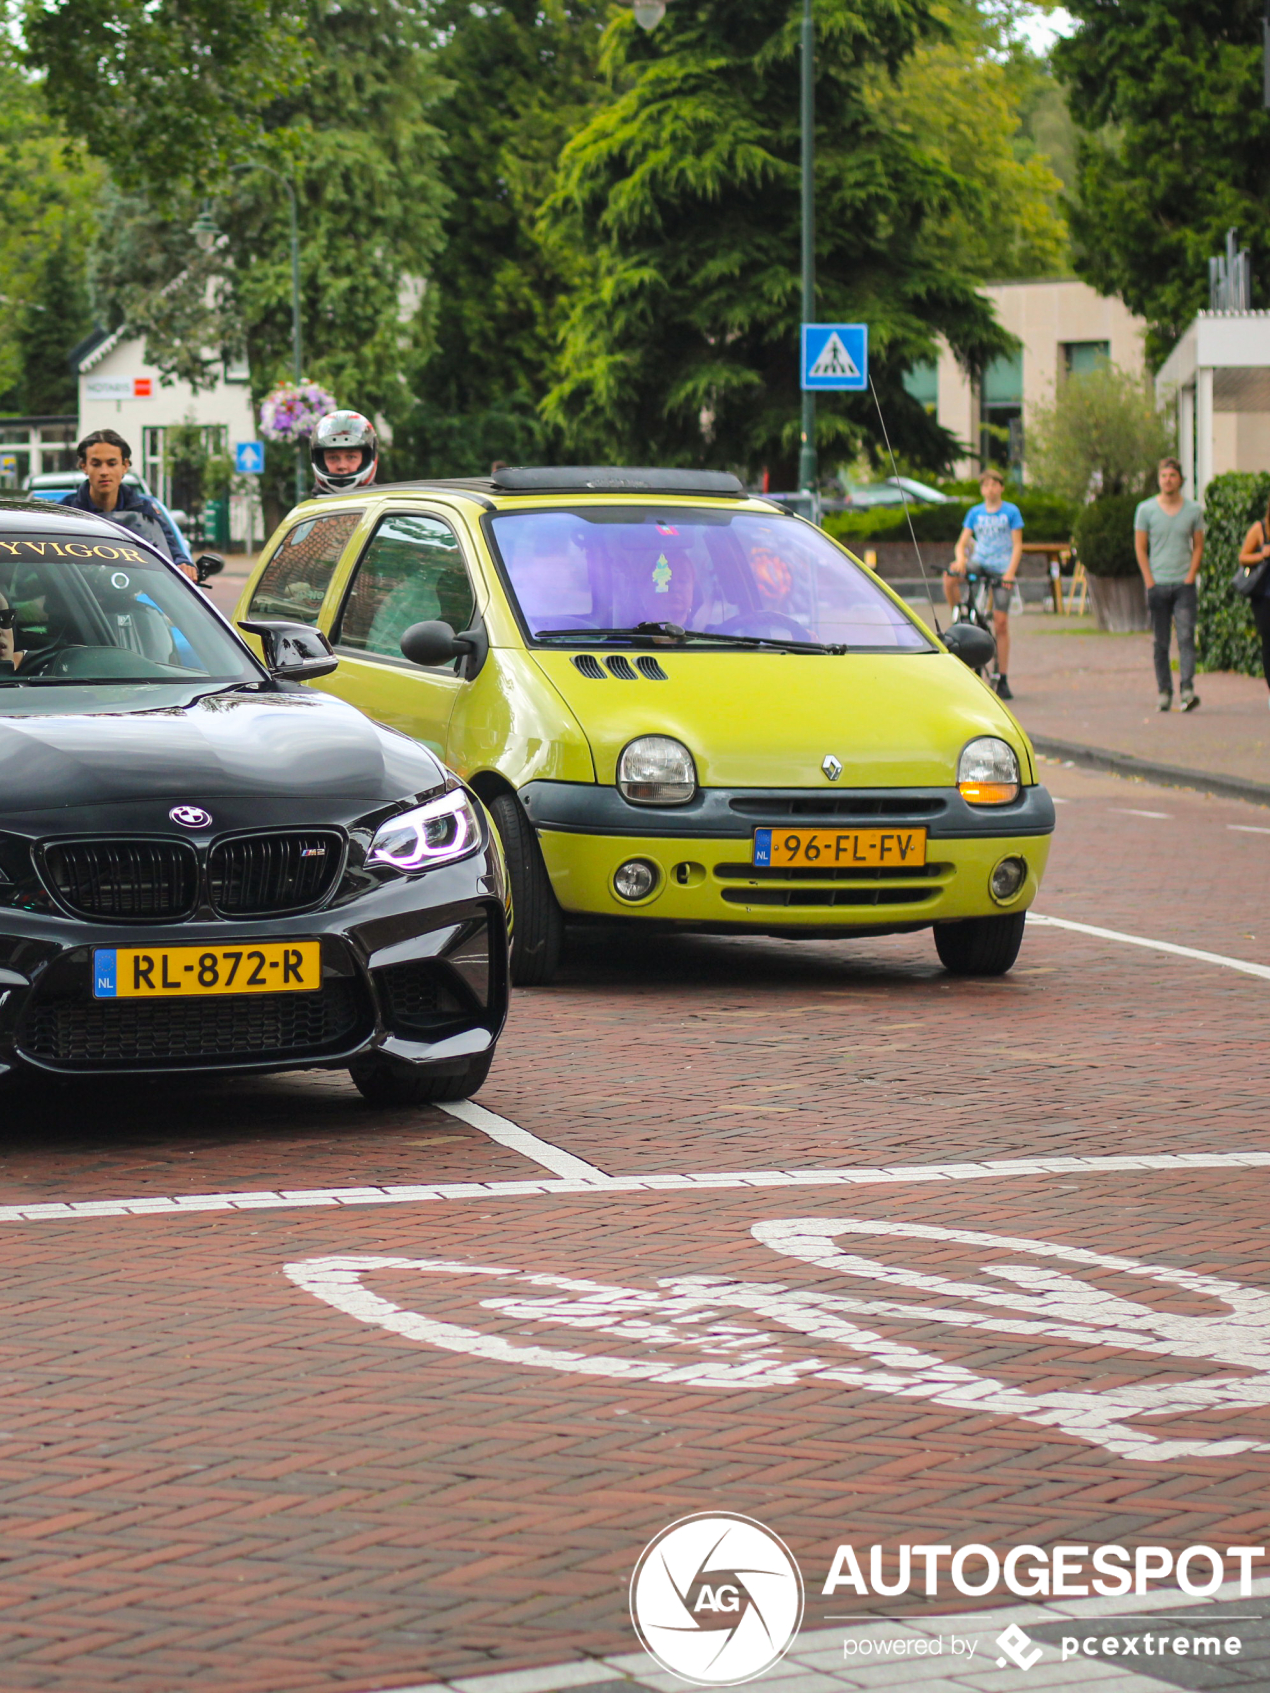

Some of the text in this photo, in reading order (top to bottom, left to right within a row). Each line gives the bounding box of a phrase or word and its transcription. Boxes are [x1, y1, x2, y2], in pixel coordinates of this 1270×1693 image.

[756, 850, 769, 861] NL
[784, 834, 913, 861] 96-FL-FV
[133, 949, 304, 990] RL-872-R
[98, 977, 114, 989] NL
